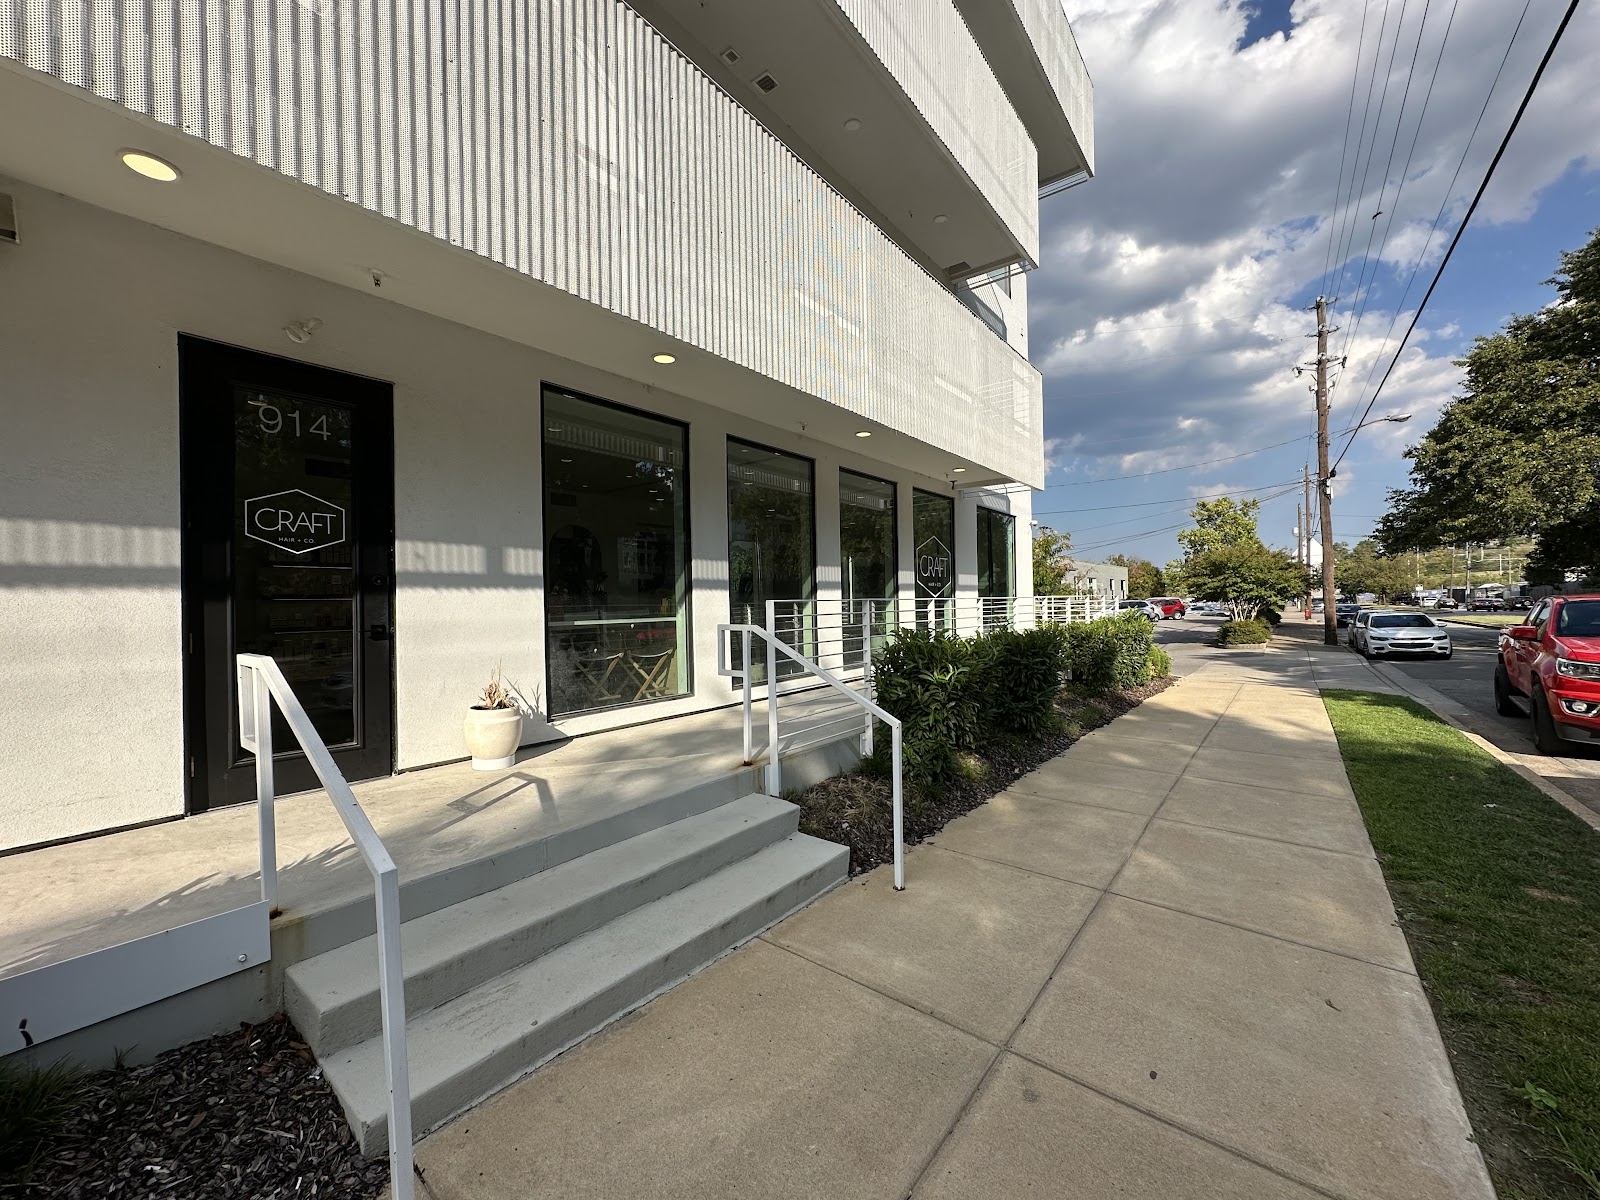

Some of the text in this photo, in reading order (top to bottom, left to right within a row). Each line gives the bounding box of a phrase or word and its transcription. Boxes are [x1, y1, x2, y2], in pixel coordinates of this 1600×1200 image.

[258, 405, 332, 441] 914
[254, 507, 337, 535] CRAFT
[919, 555, 949, 578] CRAFT
